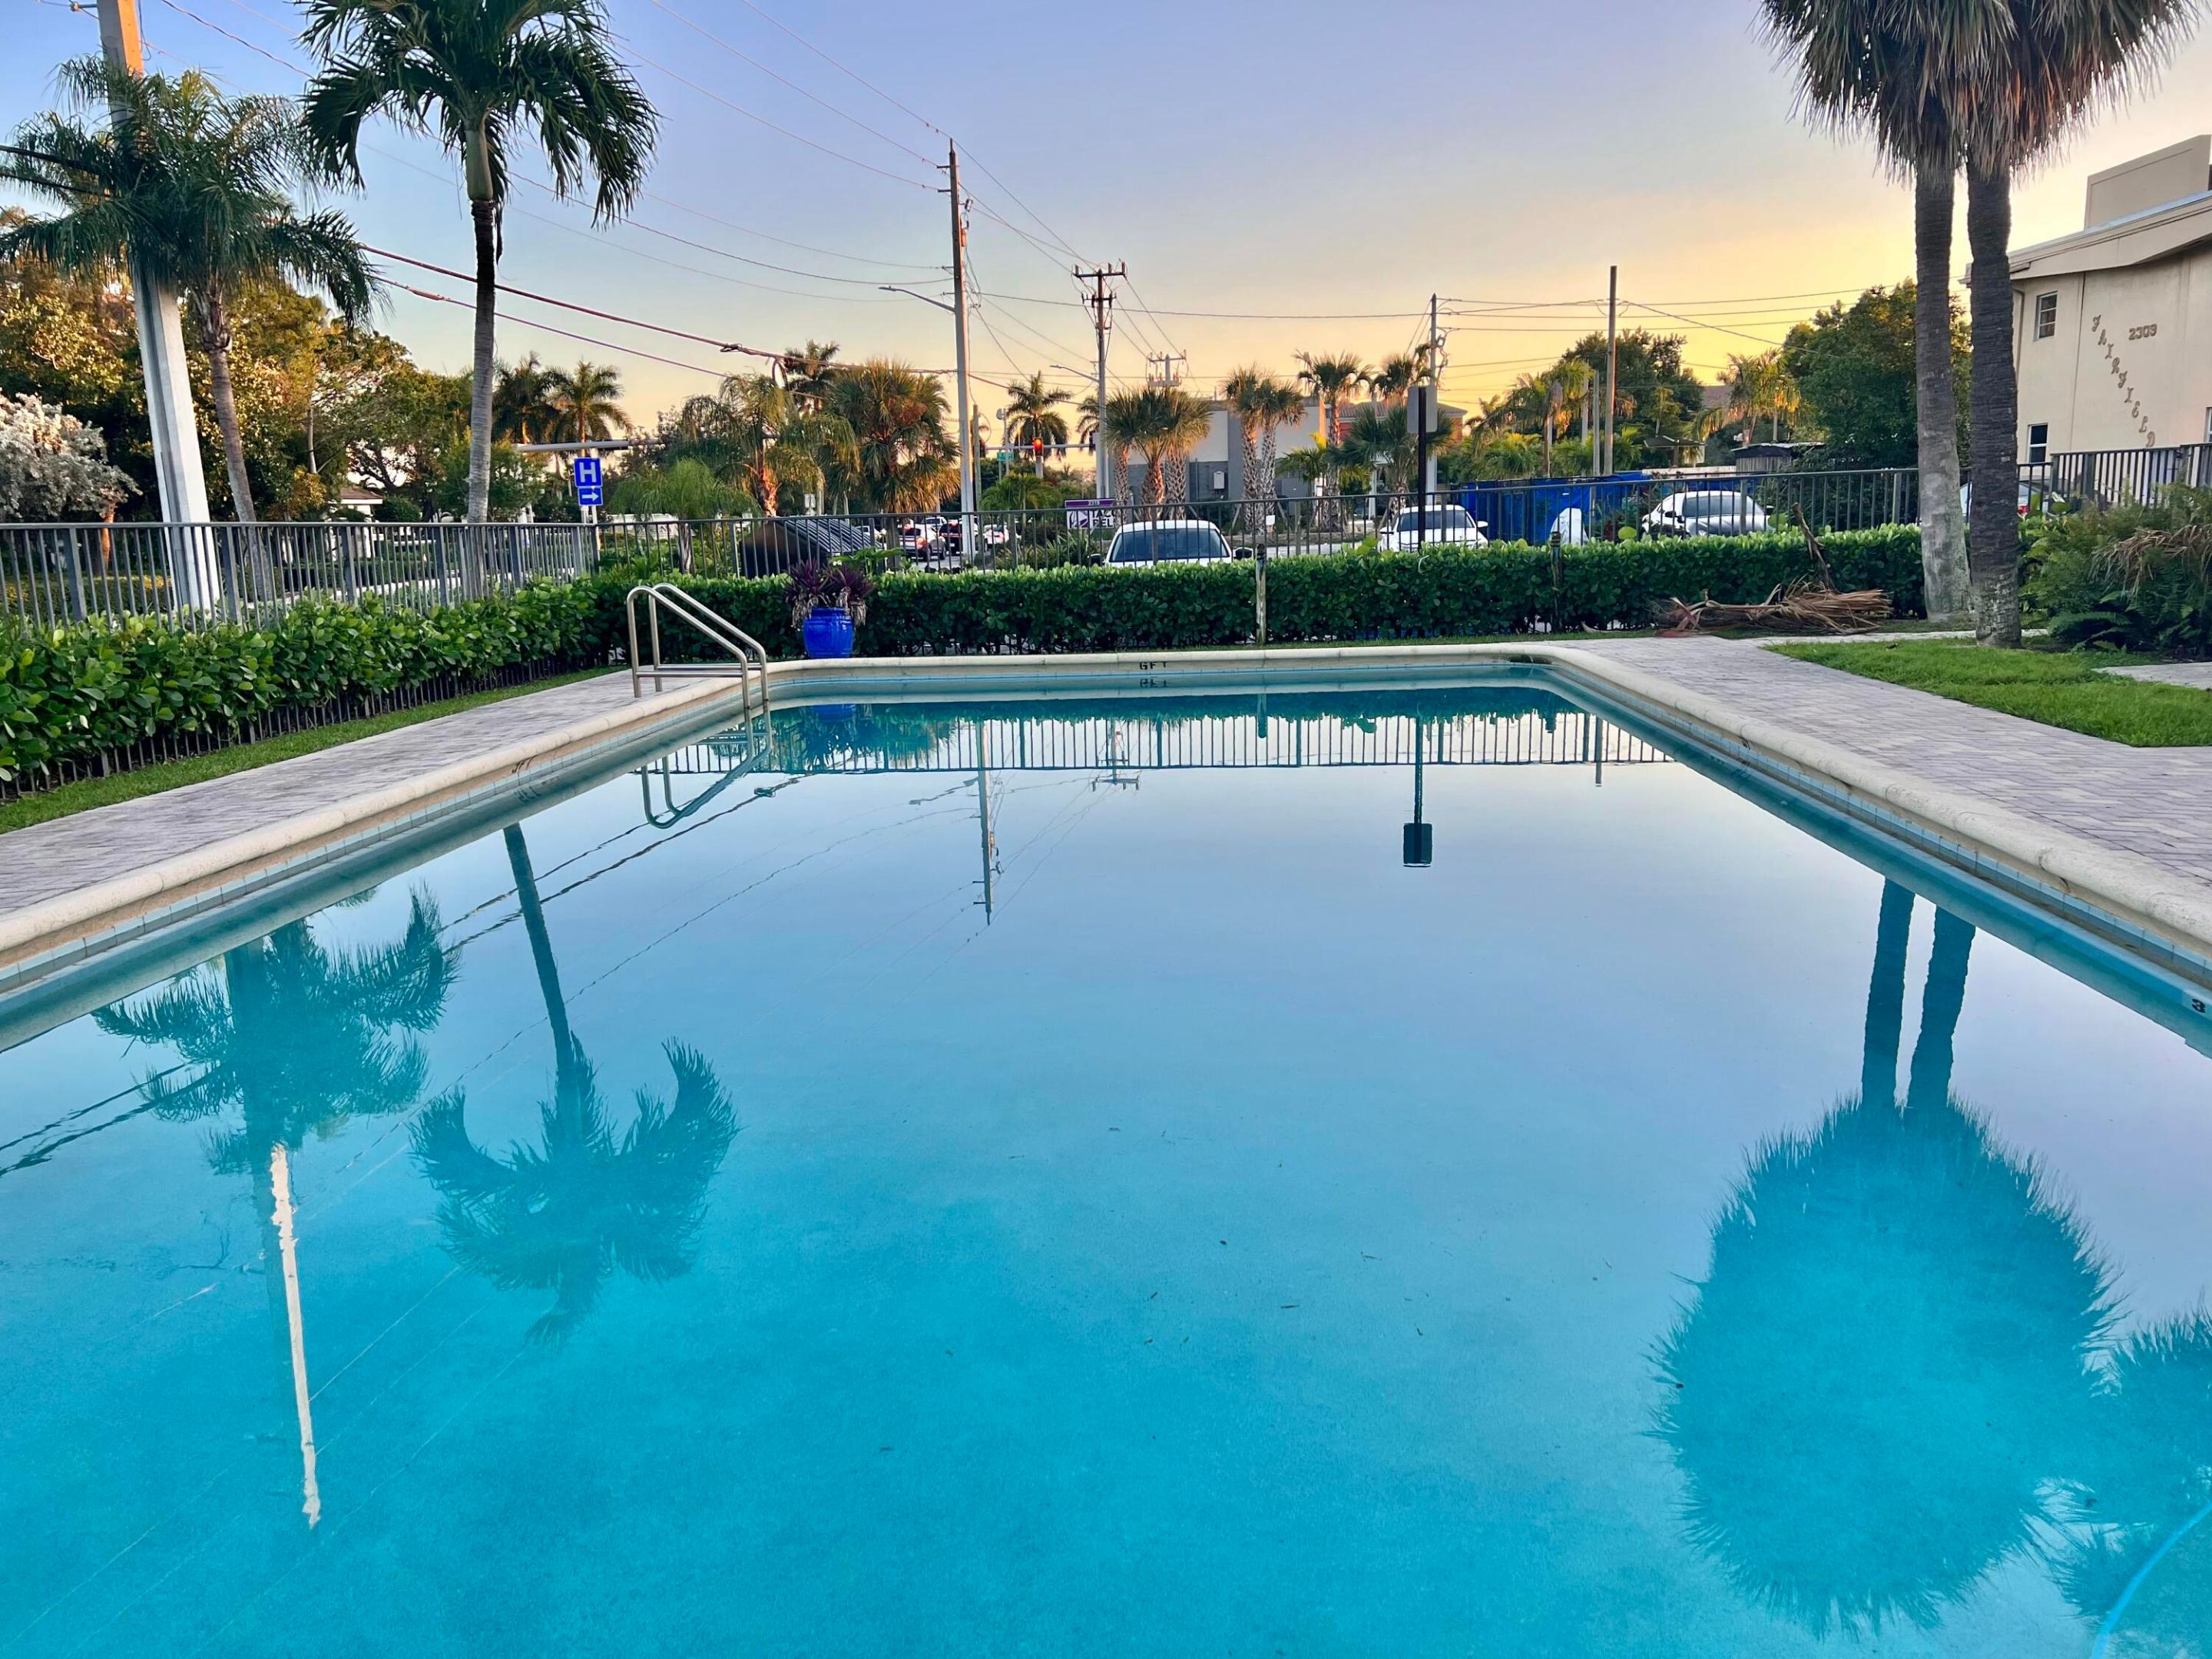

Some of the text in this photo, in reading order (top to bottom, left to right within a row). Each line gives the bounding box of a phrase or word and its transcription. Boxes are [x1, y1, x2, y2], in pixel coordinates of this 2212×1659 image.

[2129, 323, 2157, 340] 2309
[579, 462, 597, 482] H
[1093, 518, 1114, 528] BEL
[2191, 998, 2206, 1013] 3
